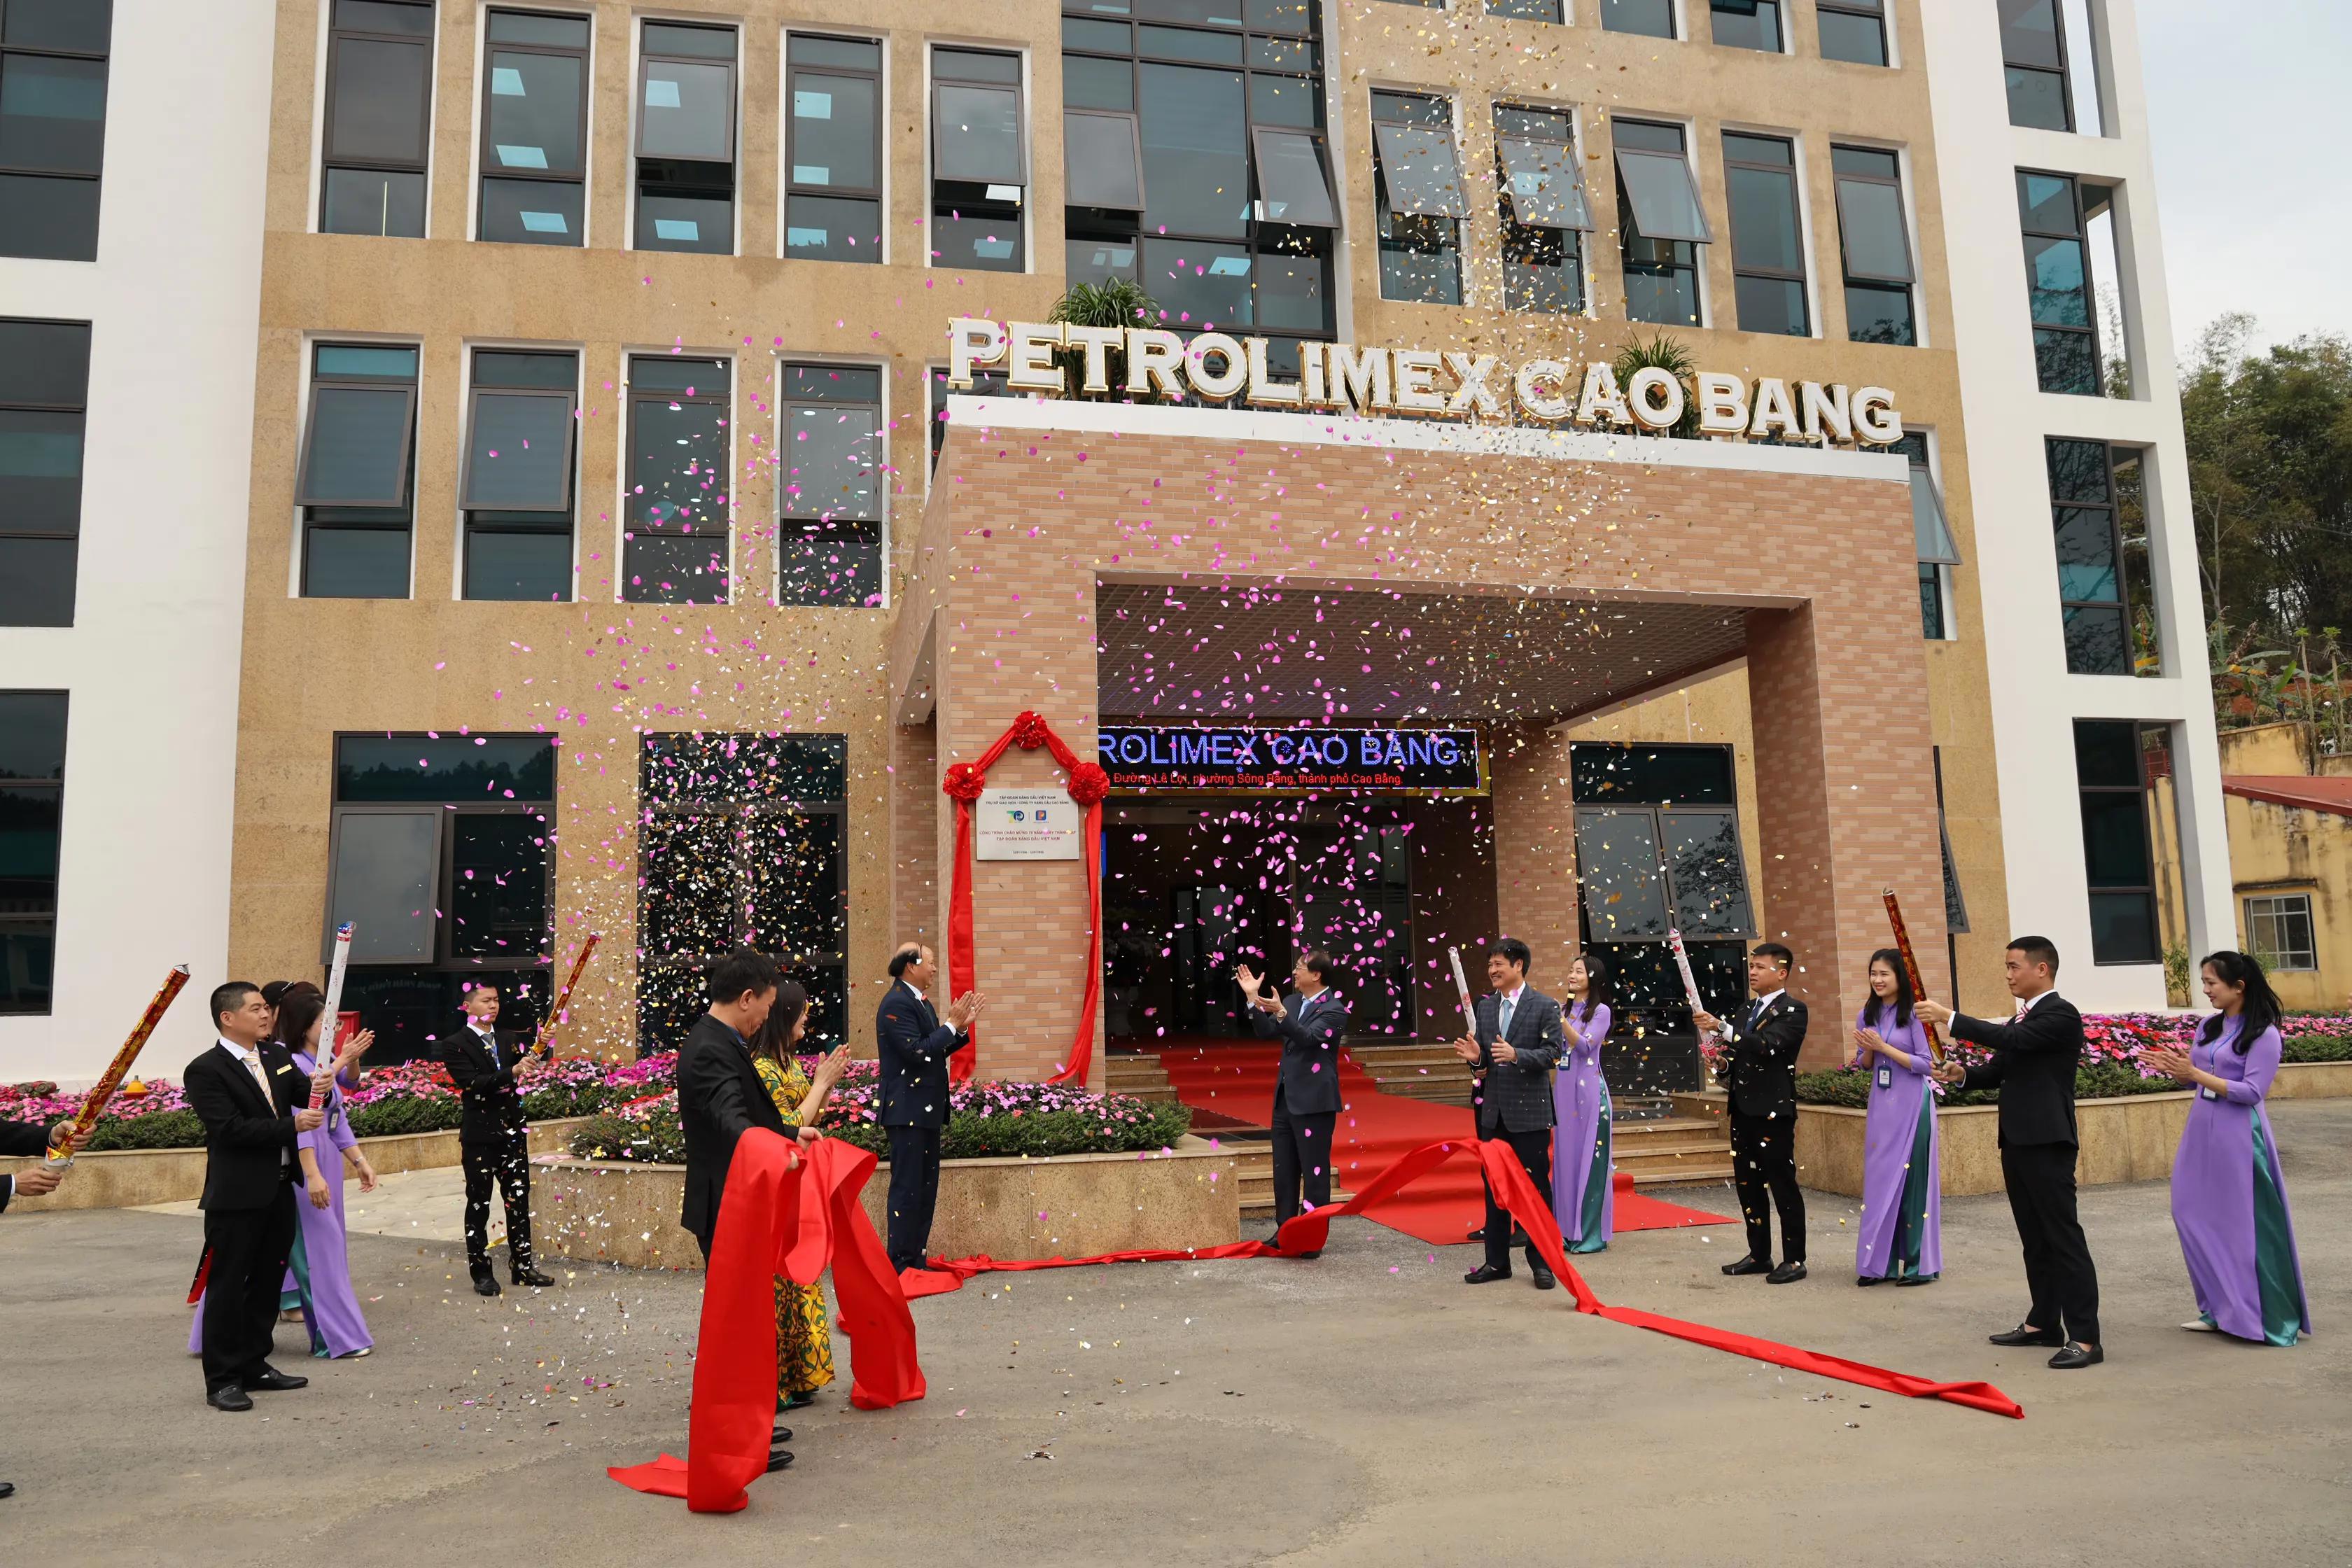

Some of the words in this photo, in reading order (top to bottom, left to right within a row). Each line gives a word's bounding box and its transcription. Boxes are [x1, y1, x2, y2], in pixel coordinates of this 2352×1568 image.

[946, 317, 1501, 419] PETROLIMEX
[1512, 358, 1684, 428] CAO
[1694, 371, 1904, 444] BANG
[1271, 736, 1348, 765] CAO
[1154, 772, 1168, 783] Lê
[1238, 773, 1264, 785] Sông
[1298, 773, 1327, 783] thành
[1352, 774, 1372, 783] Cao
